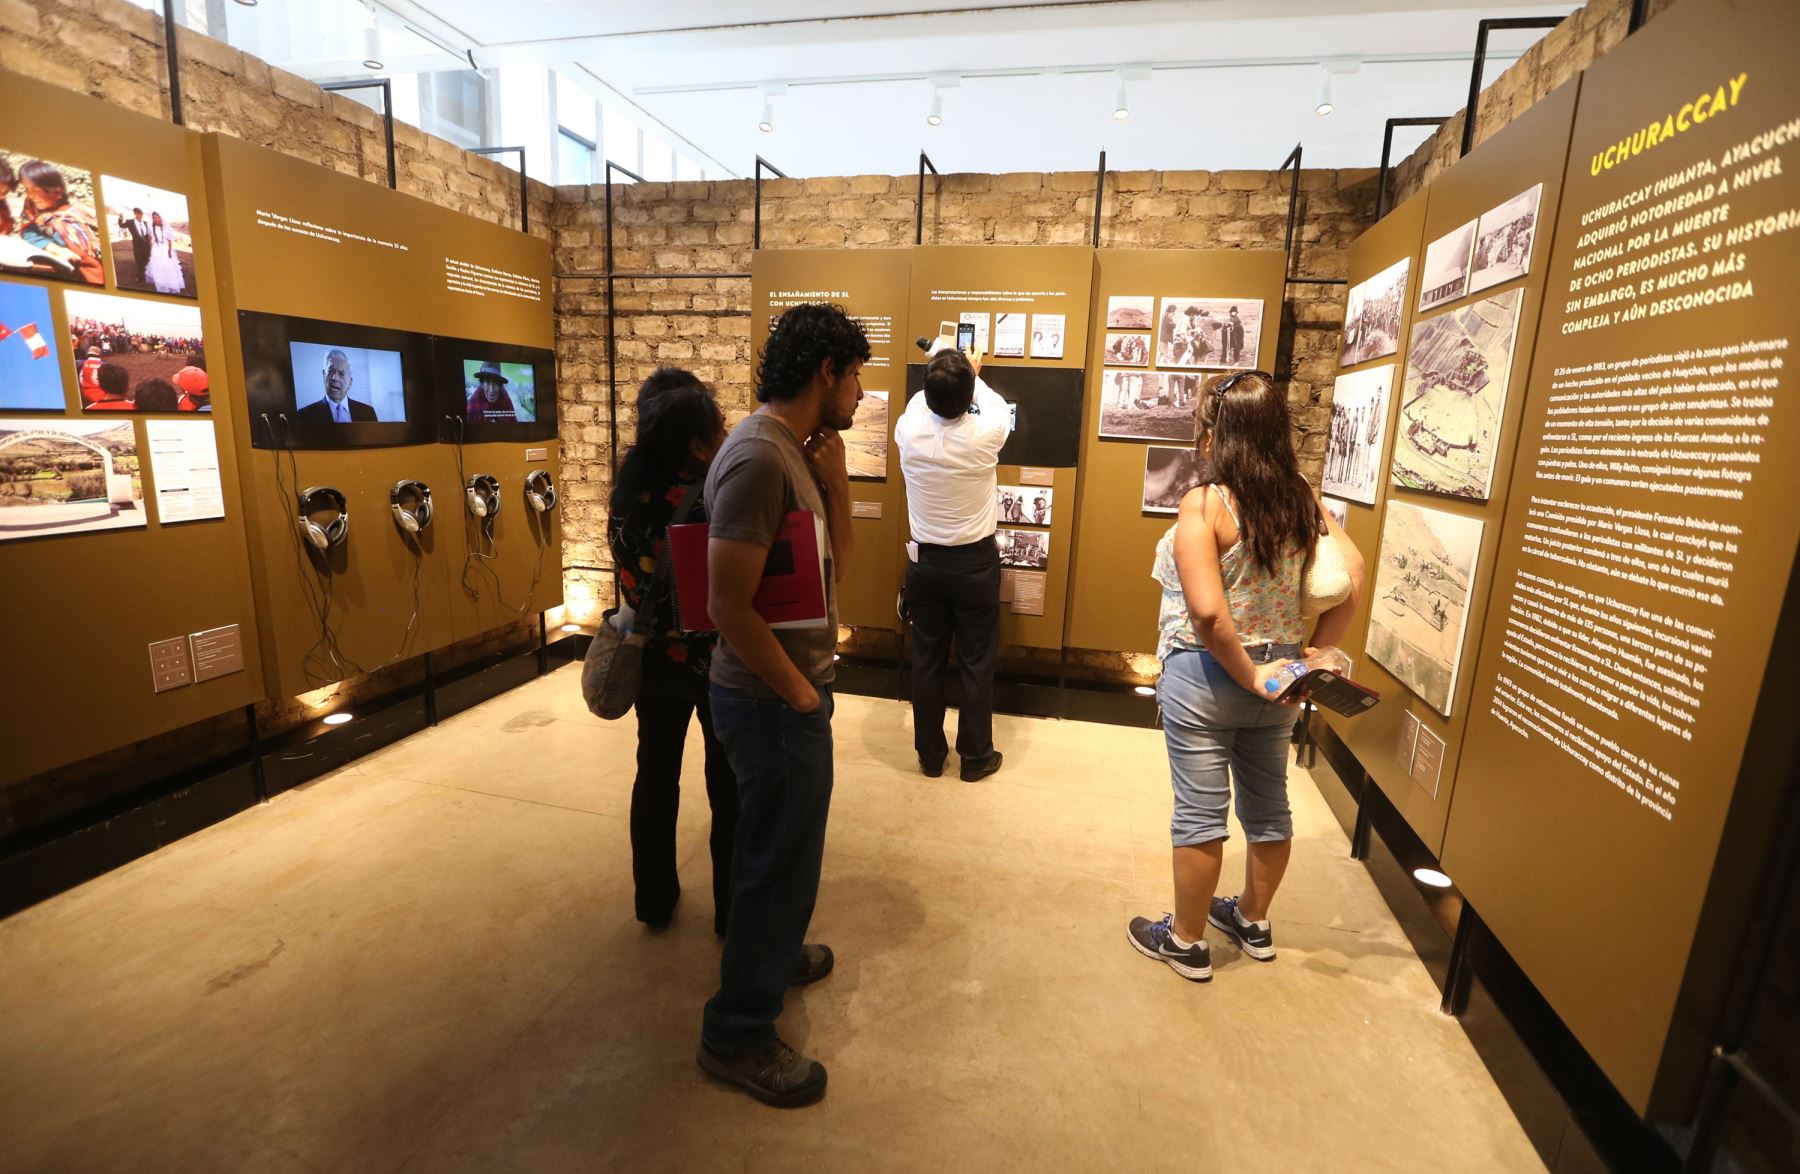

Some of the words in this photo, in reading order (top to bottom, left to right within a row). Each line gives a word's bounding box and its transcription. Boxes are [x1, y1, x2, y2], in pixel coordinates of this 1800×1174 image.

[1590, 72, 1748, 176] UCHURACCAY
[1576, 215, 1627, 248] ADQUIRIÓ
[1630, 184, 1714, 228] NOTORIEDAD
[1718, 178, 1728, 194] A
[1733, 156, 1782, 190] NIVEL
[1582, 184, 1652, 226] UCHURACCAY
[1653, 159, 1717, 196] (HUANTA,
[1574, 244, 1624, 270] NACIONAL
[1627, 232, 1650, 252] POR
[1654, 227, 1668, 244] LA
[1672, 204, 1730, 236] MUERTE
[1570, 279, 1582, 292] DE
[1584, 268, 1614, 288] OCHO
[1616, 242, 1698, 278] PERIODISTAS.
[1702, 229, 1722, 252] SU
[1566, 299, 1581, 314] SIN
[1584, 285, 1636, 310] EMBARGO,
[1640, 280, 1654, 295] ES
[1657, 264, 1708, 290] MUCHO
[1712, 252, 1746, 278] MÁS
[1562, 316, 1610, 334] COMPLEJA
[1614, 313, 1620, 324] Y
[1622, 302, 1646, 322] AÚN
[1650, 280, 1754, 317] DESCONOCIDA
[1721, 345, 1740, 357] para
[1708, 364, 1724, 376] que
[1725, 362, 1737, 372] los
[1738, 358, 1770, 371] medios
[1770, 356, 1783, 368] de
[1738, 380, 1750, 389] en
[1751, 377, 1761, 388] el
[1760, 378, 1778, 390] que
[1730, 397, 1741, 407] Se
[1742, 395, 1774, 407] trataba
[1705, 414, 1756, 425] comunidades
[1757, 414, 1769, 424] de
[1742, 432, 1750, 443] la
[1670, 449, 1710, 462] Uchuraccay
[1672, 465, 1692, 476] tomar
[1693, 466, 1720, 479] algunas
[1649, 481, 1684, 493] ejecutados
[1654, 512, 1685, 526] Fernando
[1675, 534, 1708, 549] concluyó
[1708, 540, 1724, 551] que
[1725, 541, 1738, 553] los
[1665, 548, 1675, 559] de
[1692, 553, 1733, 571] decidieron
[1670, 565, 1681, 576] los
[1682, 570, 1705, 582] cuales
[1706, 575, 1730, 588] murió
[1670, 584, 1696, 598] ocurrió
[1696, 591, 1710, 602] ese
[1664, 615, 1674, 626] de
[1674, 618, 1685, 630] las
[1654, 629, 1690, 650] incursionó
[1654, 647, 1673, 661] parte
[1674, 652, 1684, 665] de
[1684, 659, 1693, 668] su
[1644, 658, 1656, 671] fue
[1692, 678, 1704, 691] los
[1559, 681, 1586, 702] totalmente
[1663, 685, 1700, 708] solicitaron
[1662, 700, 1672, 713] los
[1624, 699, 1656, 722] diferentes
[1656, 715, 1681, 735] lugares
[1682, 728, 1692, 741] de
[1638, 757, 1647, 770] de
[1648, 763, 1658, 776] las
[1659, 771, 1680, 789] ruinas
[1645, 778, 1654, 791] En
[1655, 786, 1662, 796] el
[1626, 783, 1634, 796] de
[1635, 789, 1641, 800] la
[1641, 795, 1672, 821] provincia
